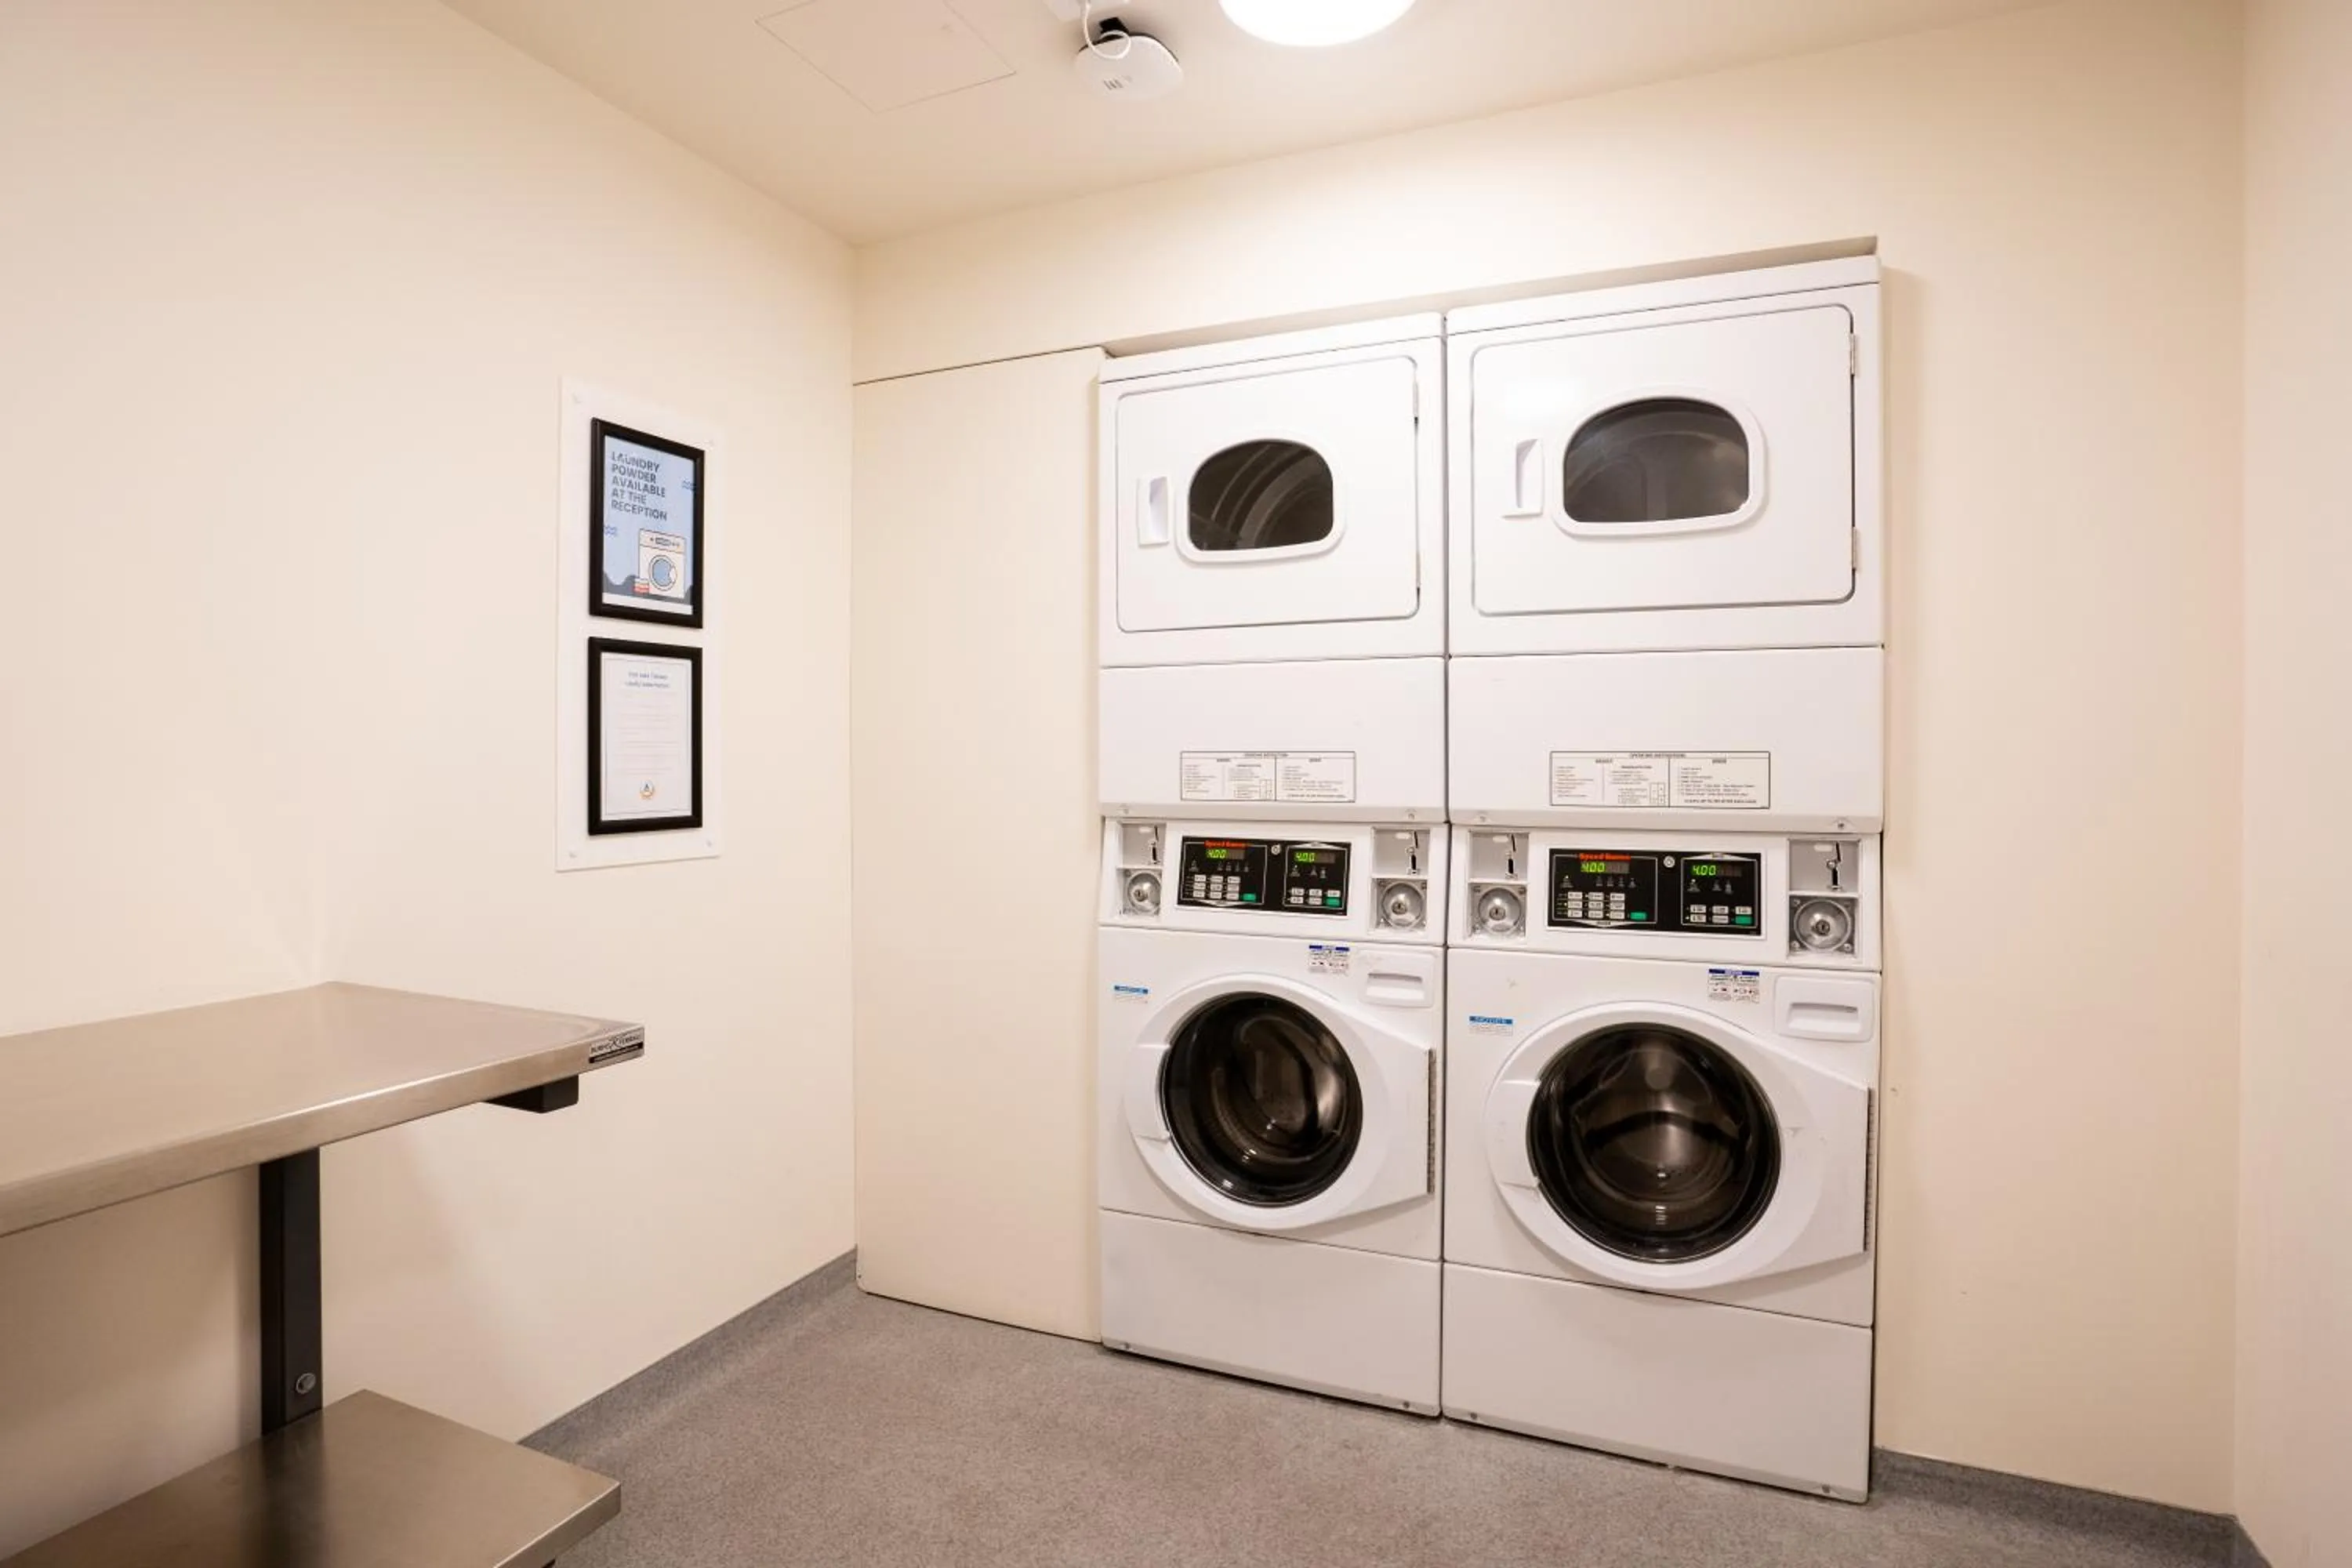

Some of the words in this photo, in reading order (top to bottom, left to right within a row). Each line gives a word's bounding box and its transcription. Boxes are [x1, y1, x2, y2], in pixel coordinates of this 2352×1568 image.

[612, 452, 660, 473] LAUNDRY
[612, 463, 656, 484] POWDER
[612, 476, 666, 498] AVAILABLE
[612, 488, 625, 499] AT
[629, 492, 647, 504] THE
[612, 499, 668, 521] RECEPTION
